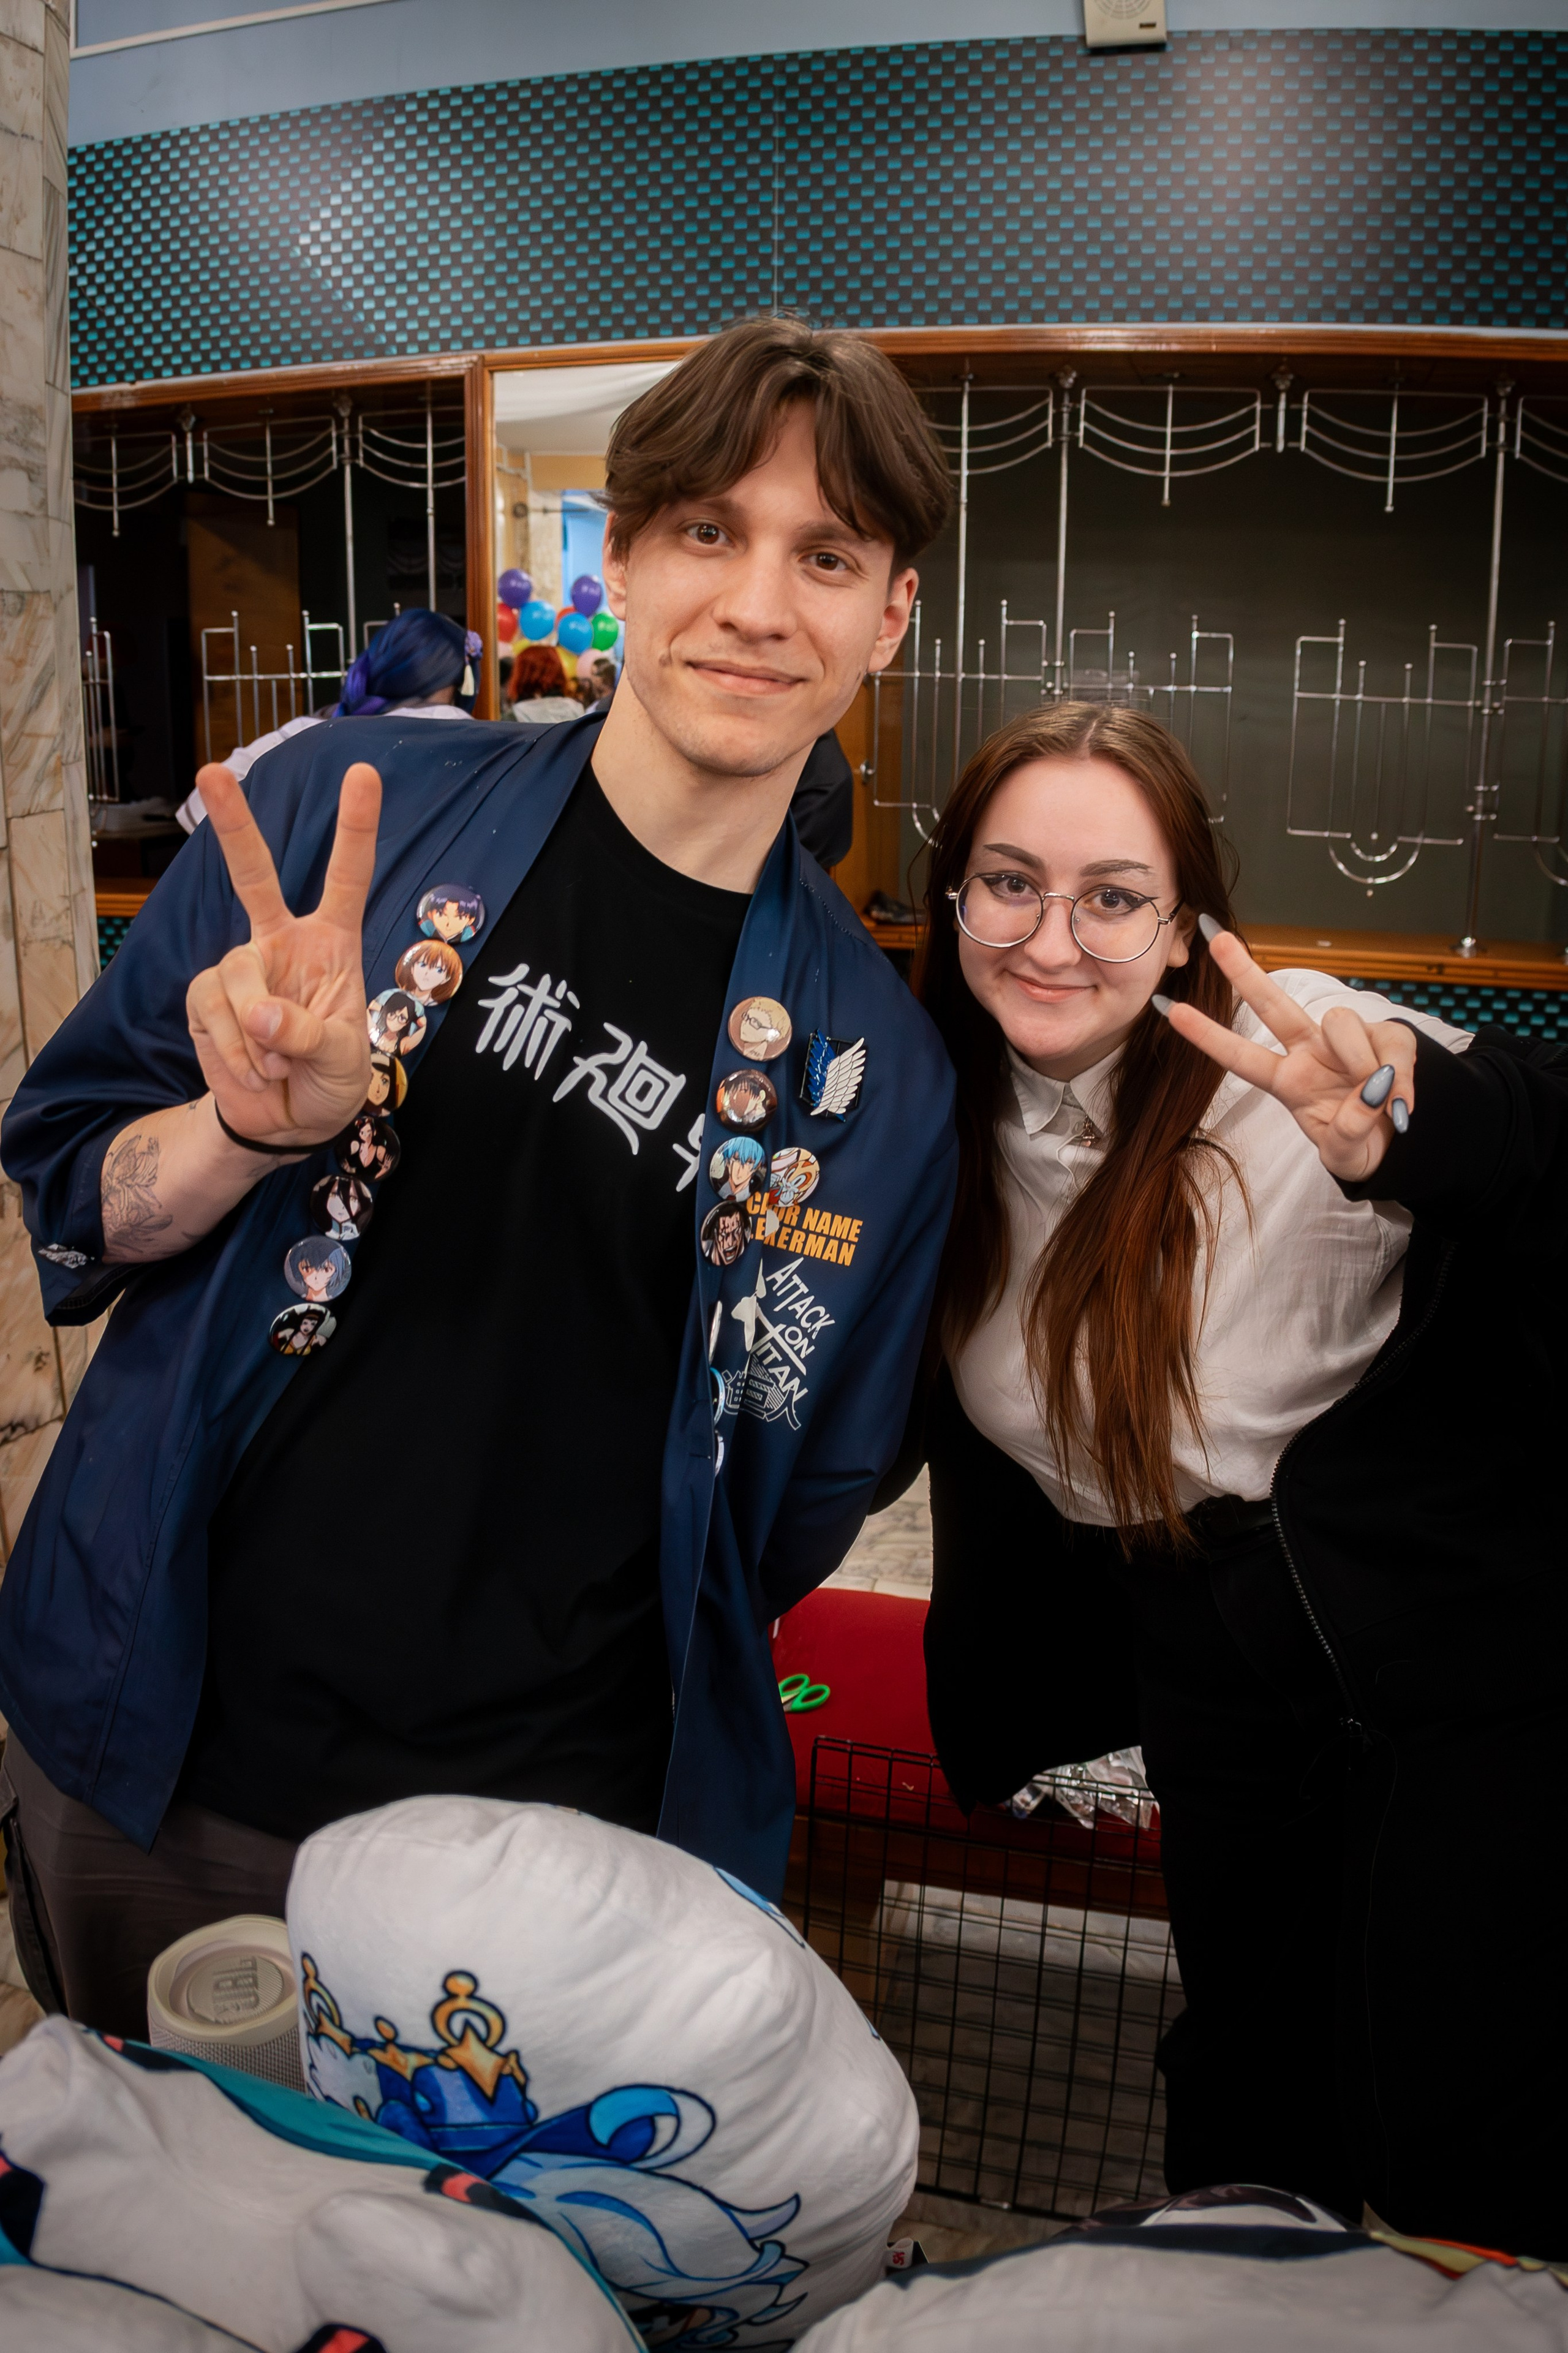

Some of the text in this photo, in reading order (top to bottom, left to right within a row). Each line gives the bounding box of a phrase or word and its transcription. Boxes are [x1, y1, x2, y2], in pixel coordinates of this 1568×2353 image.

[475, 963, 705, 1192] 術廻
[802, 1207, 864, 1243] NAME
[766, 1256, 835, 1340] ATTACK
[785, 1326, 815, 1359] ON
